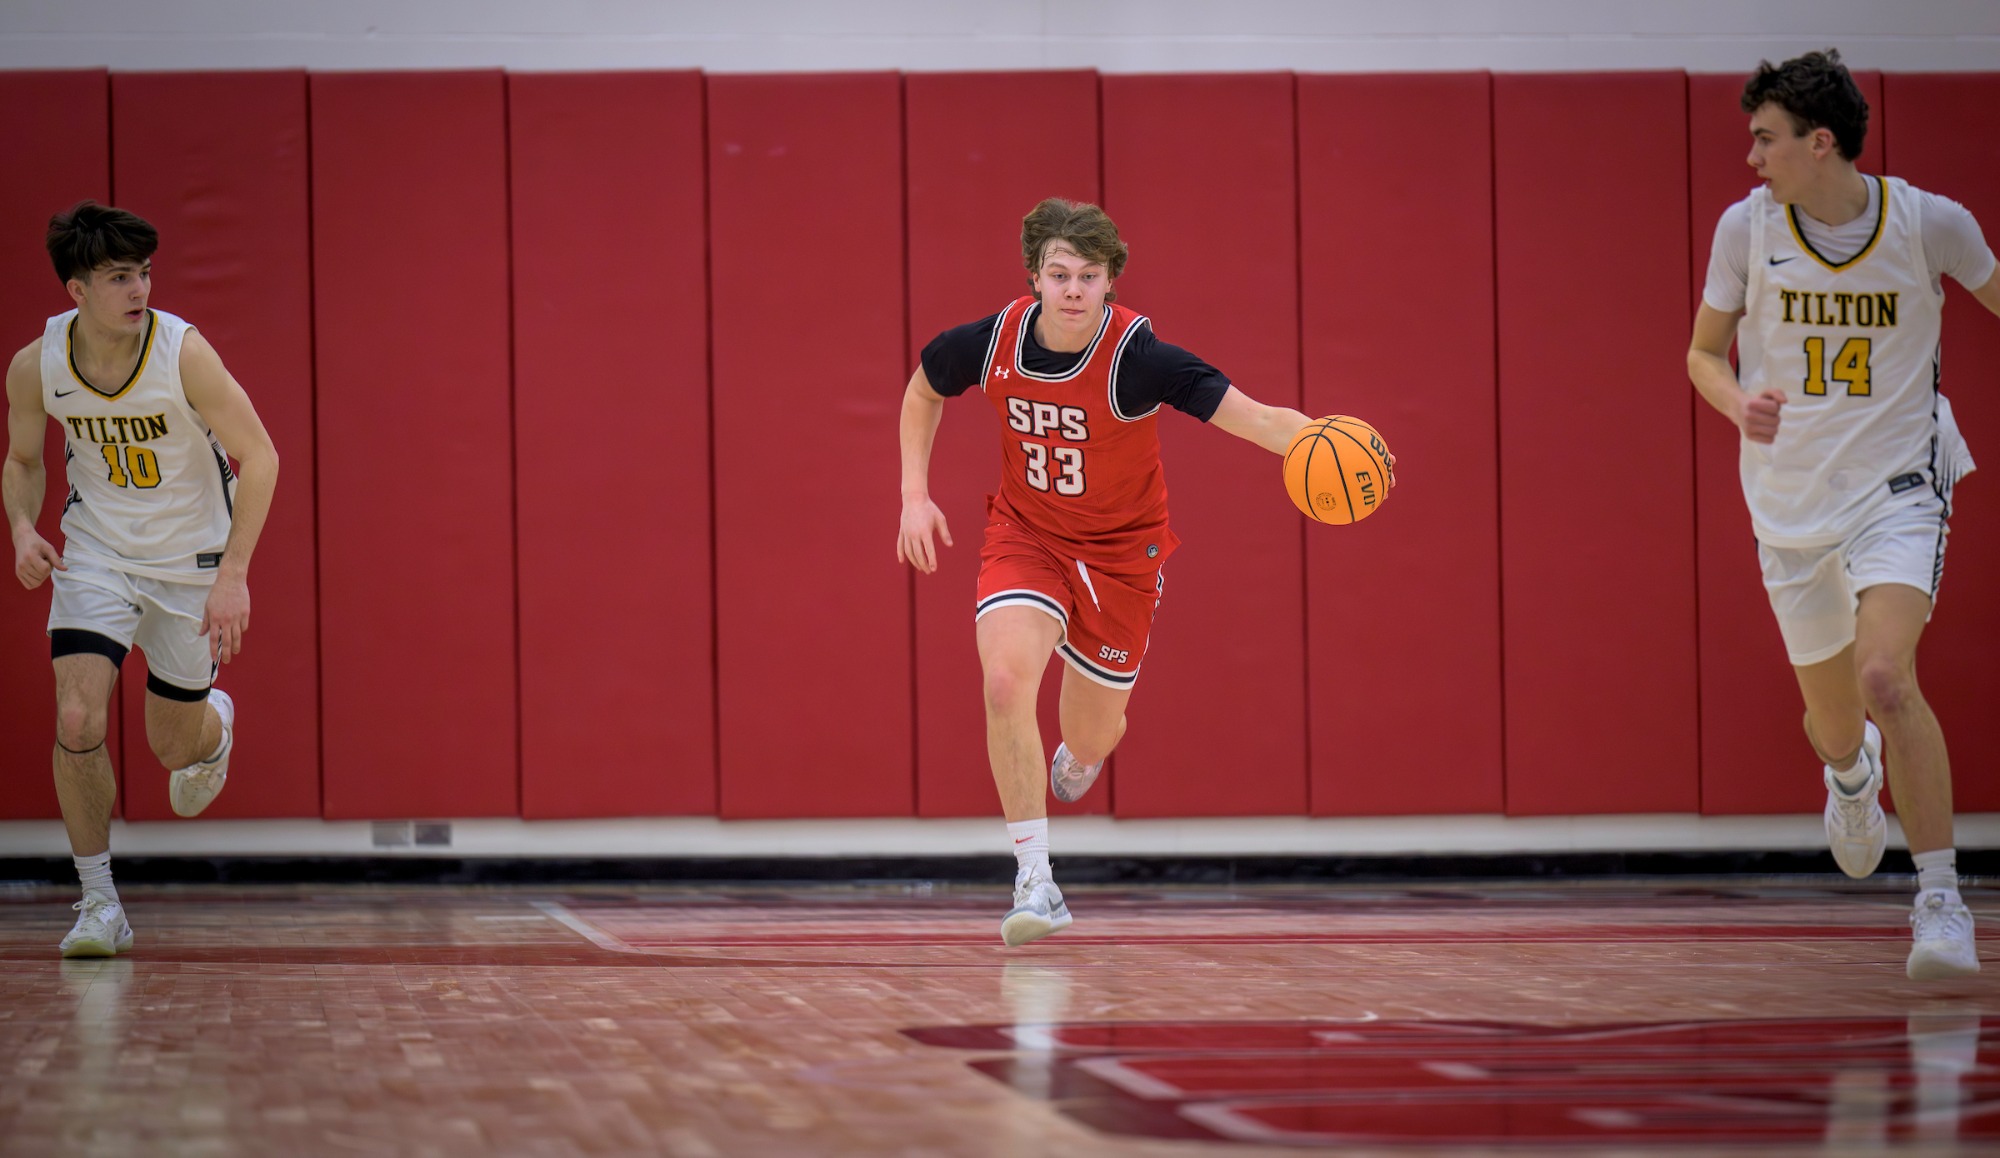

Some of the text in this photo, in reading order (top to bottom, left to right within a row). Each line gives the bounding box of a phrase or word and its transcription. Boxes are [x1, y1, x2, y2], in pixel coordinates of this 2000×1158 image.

[1780, 288, 1899, 328] TILTON
[1803, 336, 1872, 397] 14
[66, 413, 169, 444] TILTON
[1006, 396, 1090, 442] SPS
[101, 444, 162, 488] 10
[1020, 441, 1087, 497] 33
[1098, 644, 1130, 664] SPS
